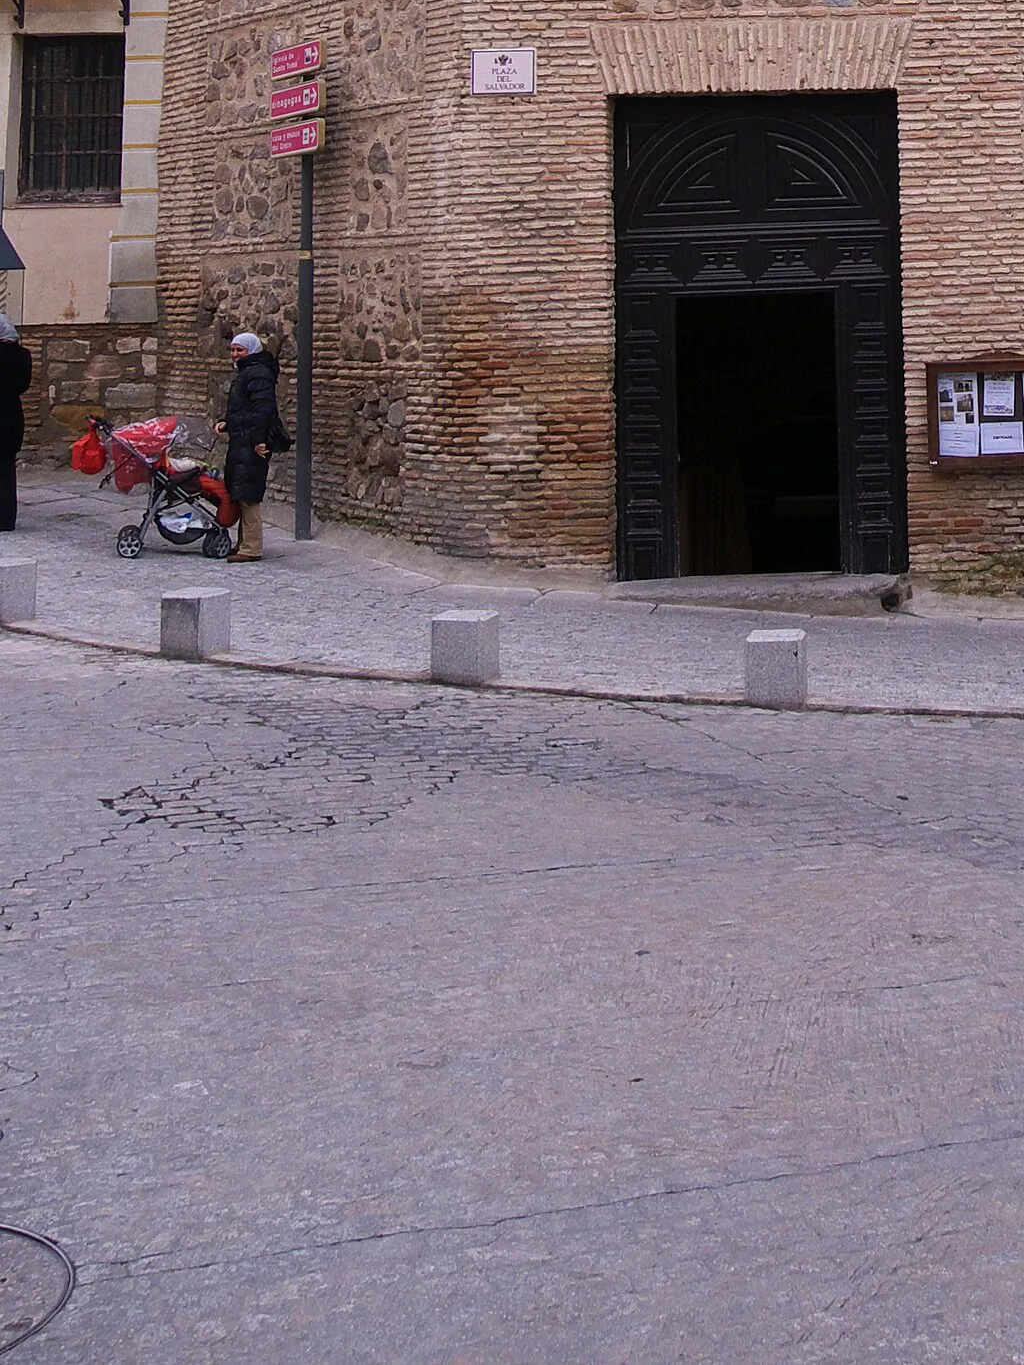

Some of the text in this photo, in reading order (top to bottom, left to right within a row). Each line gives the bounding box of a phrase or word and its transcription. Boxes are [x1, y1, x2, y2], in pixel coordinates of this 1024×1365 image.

[491, 67, 518, 75] PLAZA
[496, 75, 512, 83] DEL
[484, 82, 526, 91] SALVADOR
